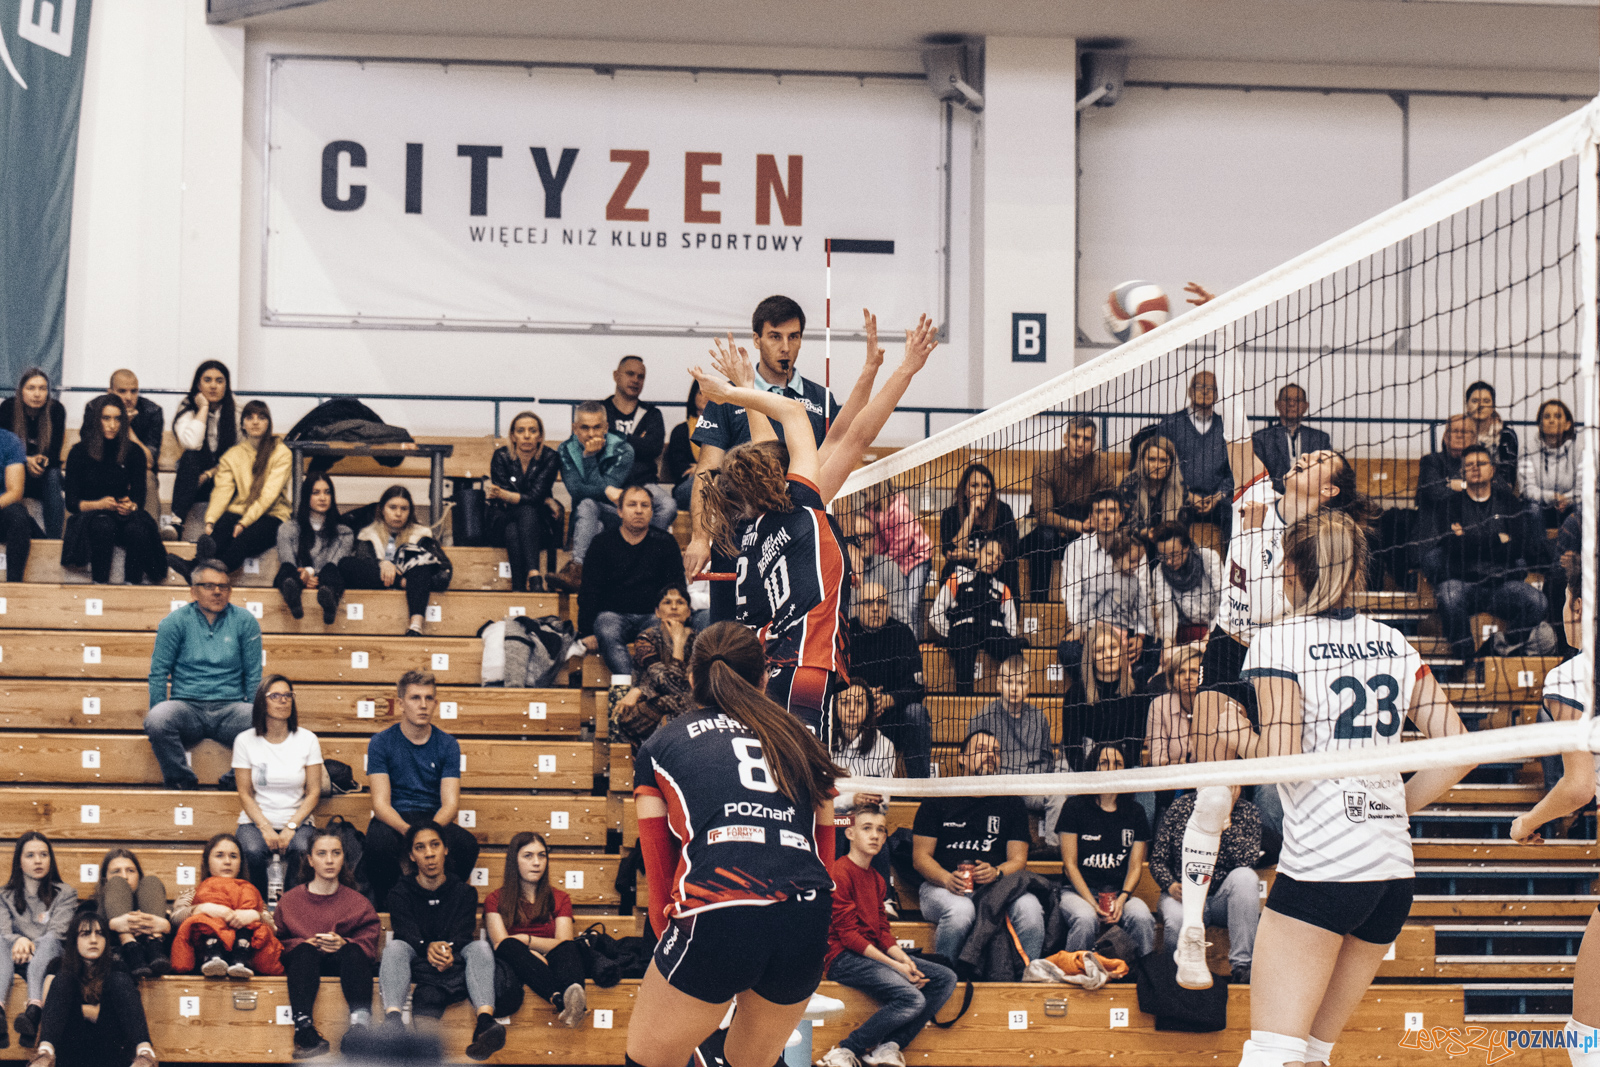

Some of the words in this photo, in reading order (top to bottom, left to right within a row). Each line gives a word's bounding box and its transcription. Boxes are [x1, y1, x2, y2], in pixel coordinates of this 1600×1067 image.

[321, 139, 803, 227] CITYZEN
[469, 226, 548, 248] WIĘCEJ
[562, 228, 598, 246] NIŻ
[611, 230, 668, 248] KLUB
[681, 232, 804, 252] SPORTOWY
[1017, 319, 1041, 356] B
[1308, 640, 1398, 661] CZEKALSKA
[1329, 673, 1401, 739] 23
[731, 737, 779, 793] 8
[1012, 1013, 1024, 1024] 13
[1114, 1011, 1126, 1021] 12
